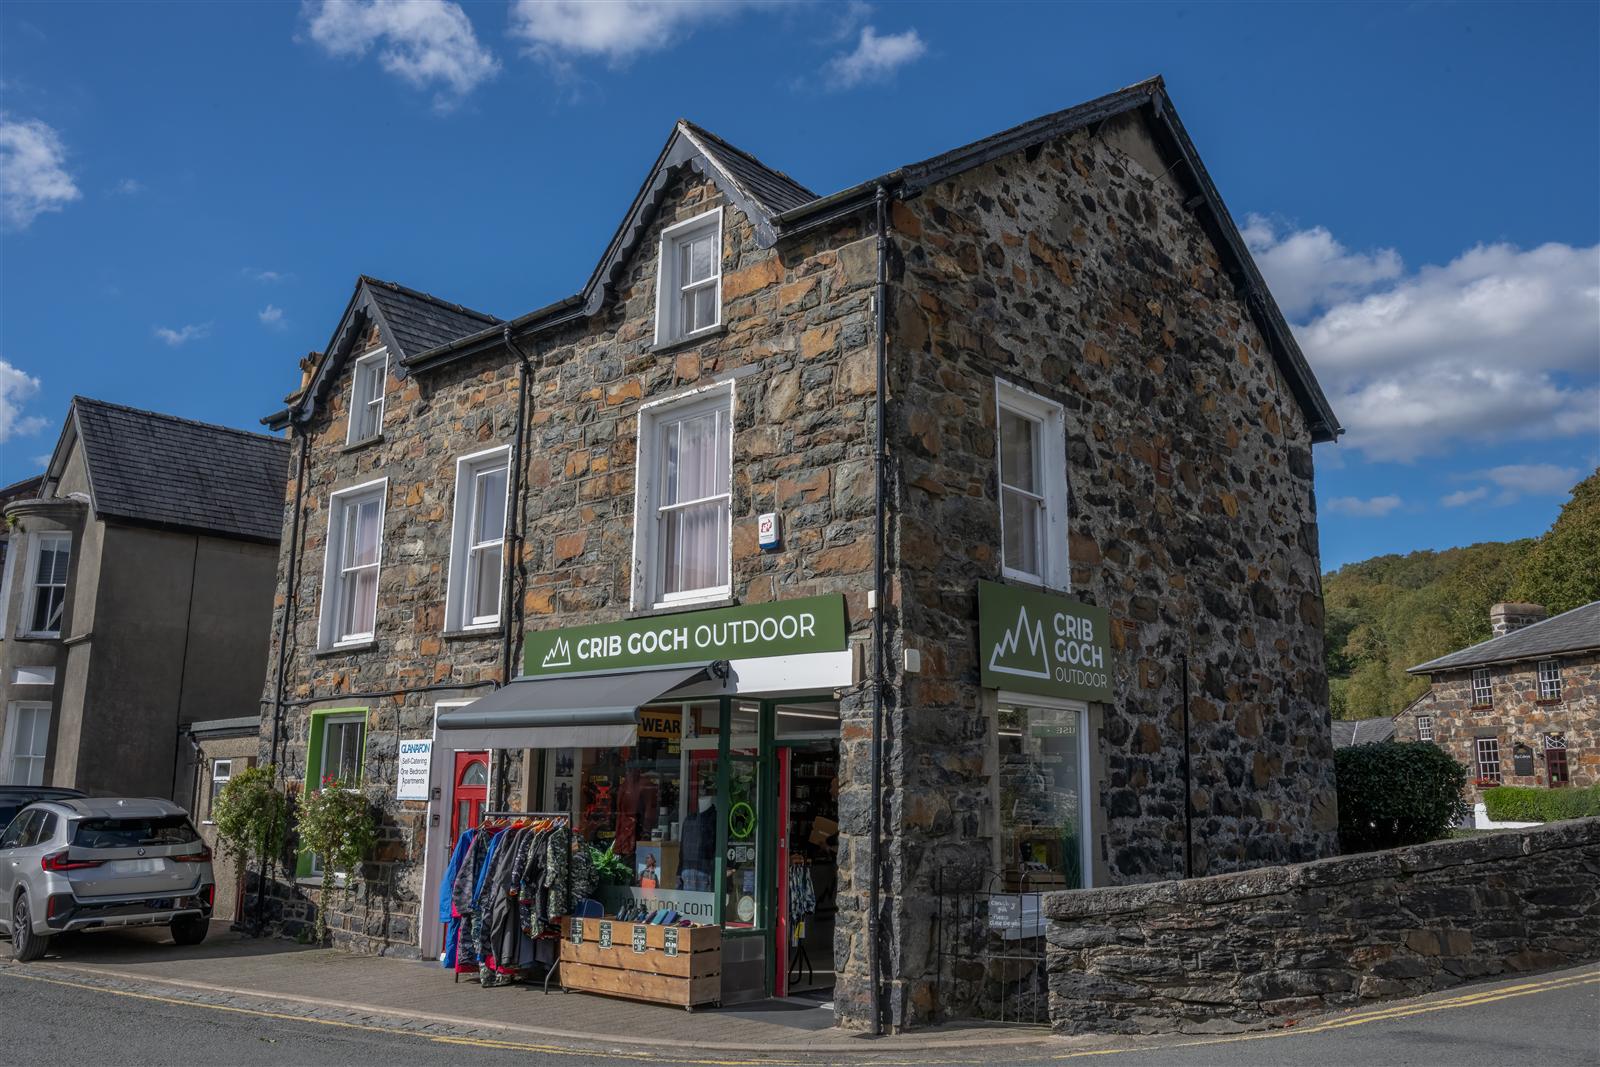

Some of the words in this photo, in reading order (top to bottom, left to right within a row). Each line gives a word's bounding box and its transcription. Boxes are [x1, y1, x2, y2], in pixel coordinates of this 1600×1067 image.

[577, 635, 621, 659] CRIB
[627, 628, 688, 655] GOCH
[695, 613, 816, 648] OUTDOOR
[1054, 612, 1093, 642] CRIB
[1055, 638, 1103, 669] GOCH
[1055, 666, 1107, 688] OUTDOOR
[641, 717, 681, 733] WEAR
[402, 757, 428, 766] Self-Catering
